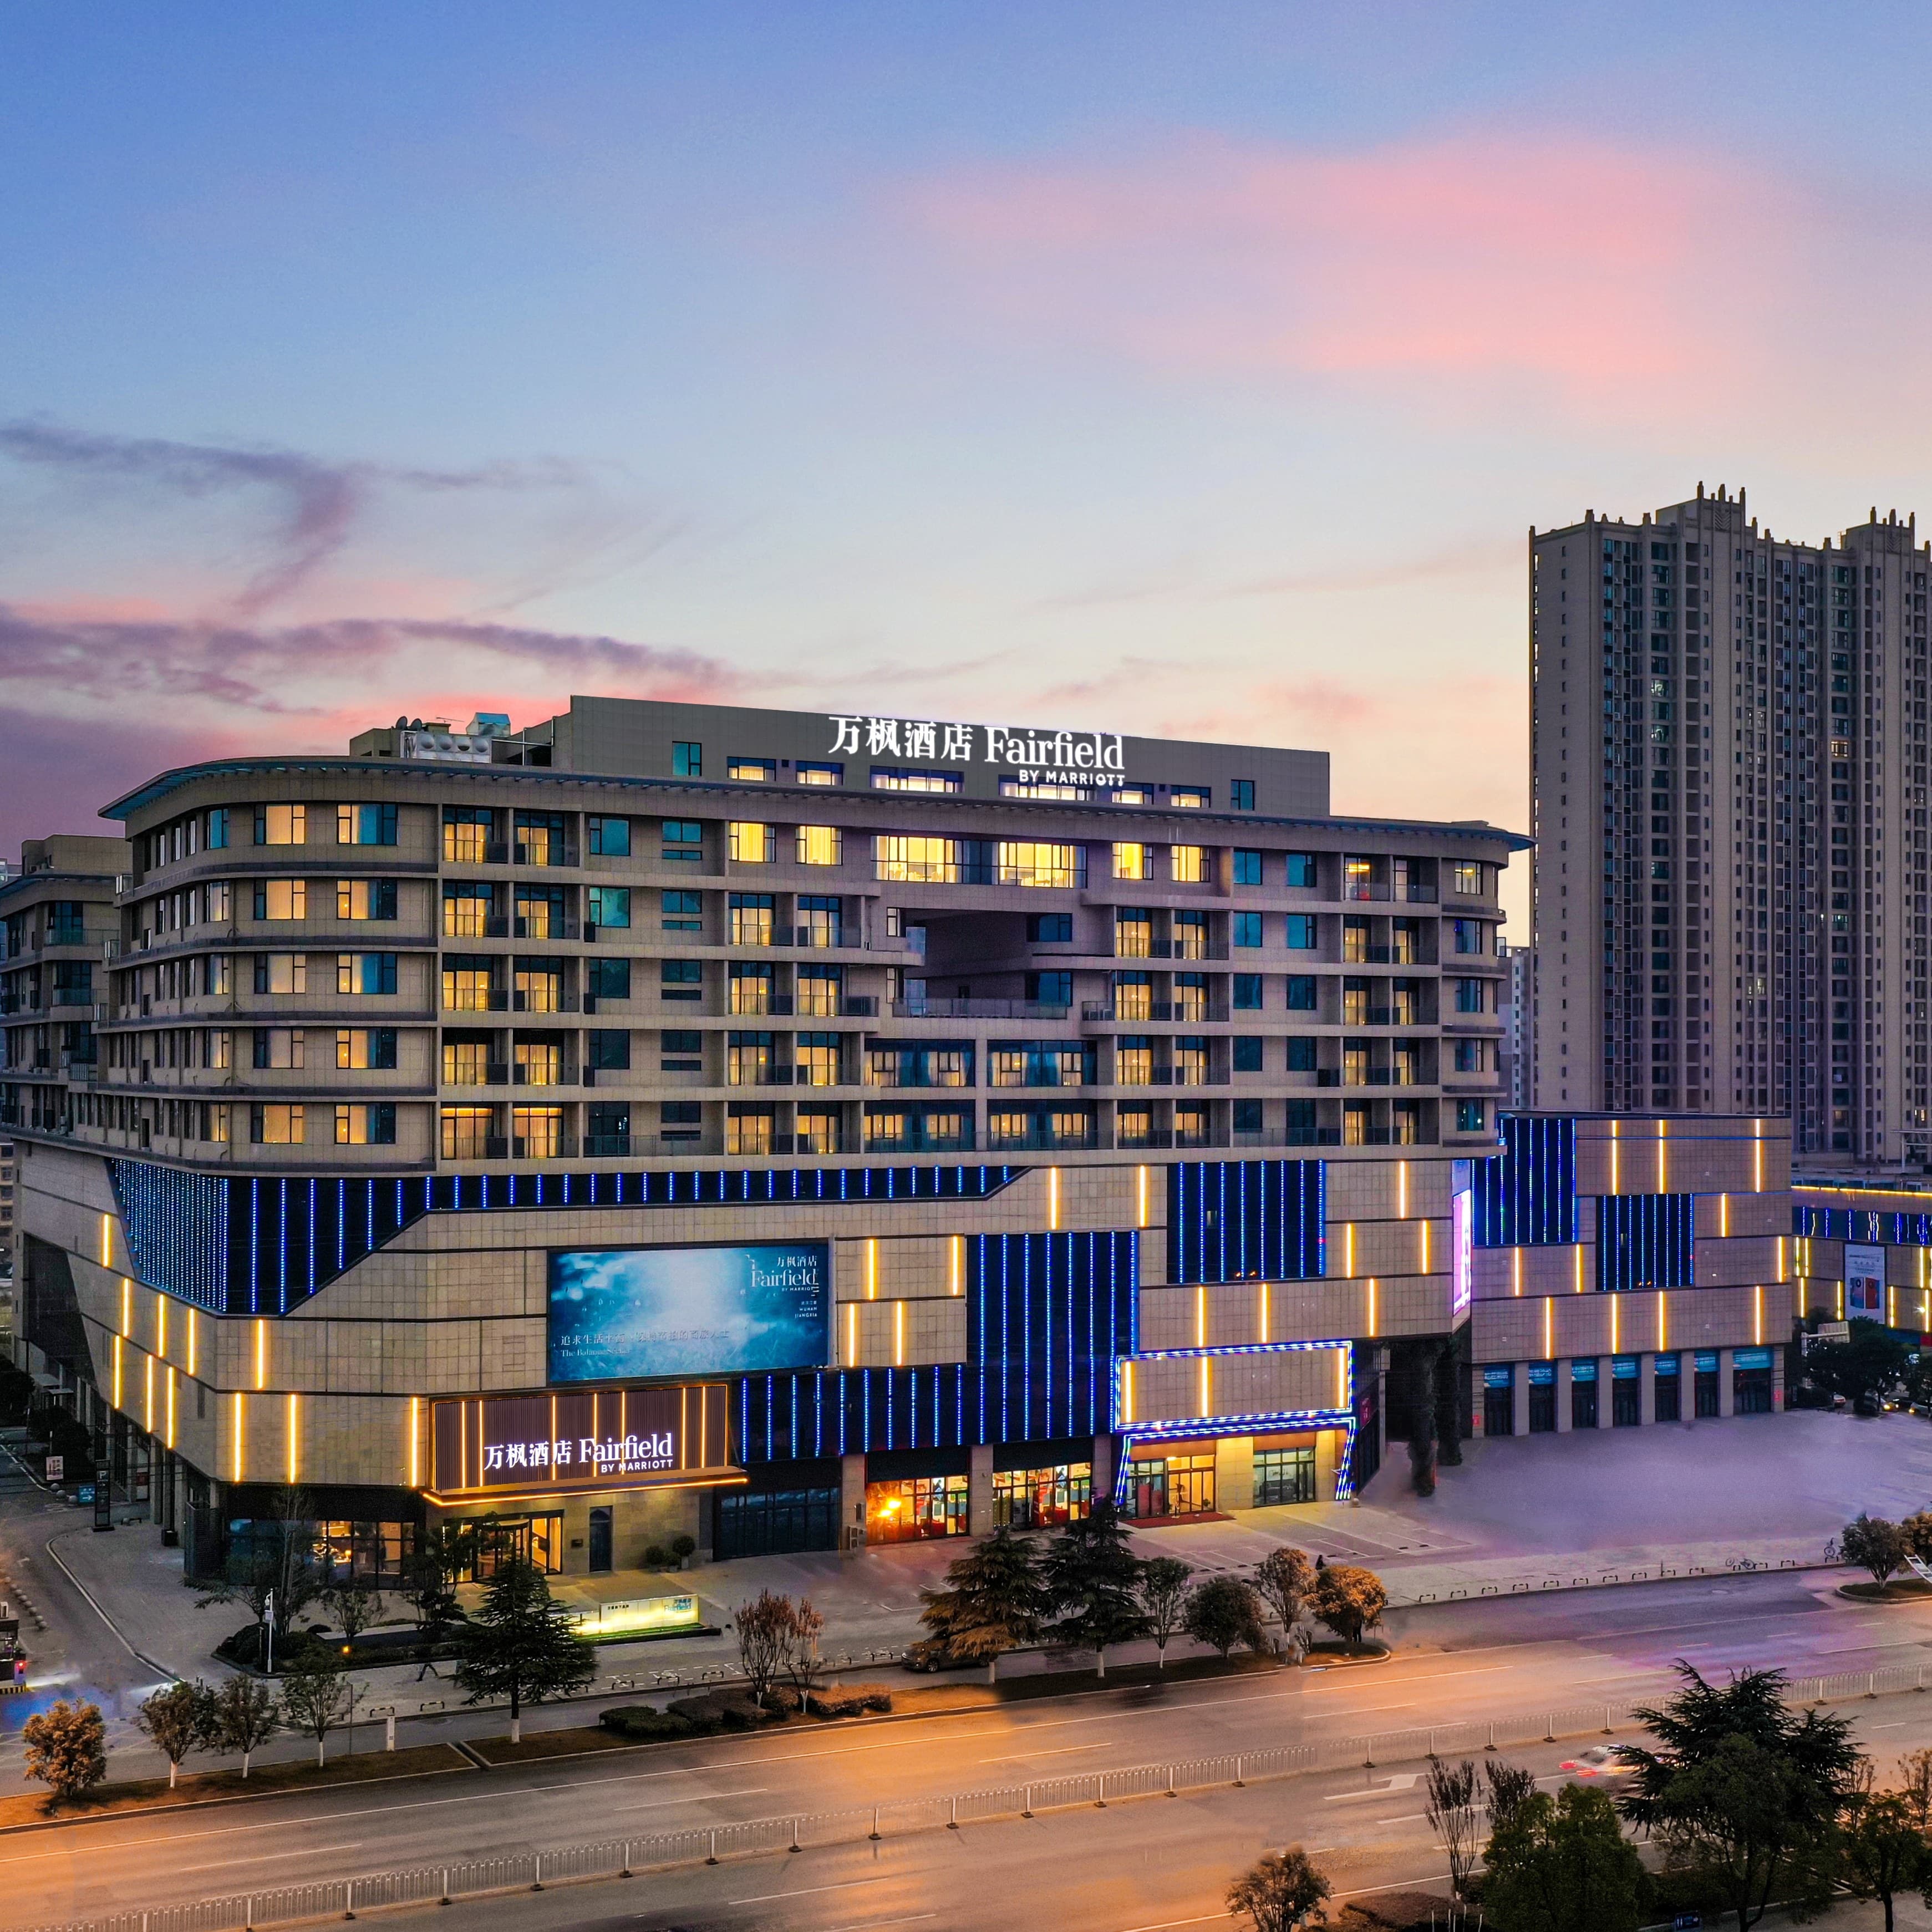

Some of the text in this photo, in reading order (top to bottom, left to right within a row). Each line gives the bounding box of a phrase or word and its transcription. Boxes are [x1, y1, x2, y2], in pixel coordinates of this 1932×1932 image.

[828, 716, 973, 761] 万枫酒店
[984, 726, 1125, 770] Fairfield
[1019, 770, 1125, 786] BY MARRIOTT
[751, 1268, 819, 1287] Fairfield
[484, 1441, 572, 1470] 万枫酒店
[578, 1432, 673, 1463] Fairfield
[99, 1471, 106, 1479] P
[601, 1459, 673, 1473] BY MARRIOTT
